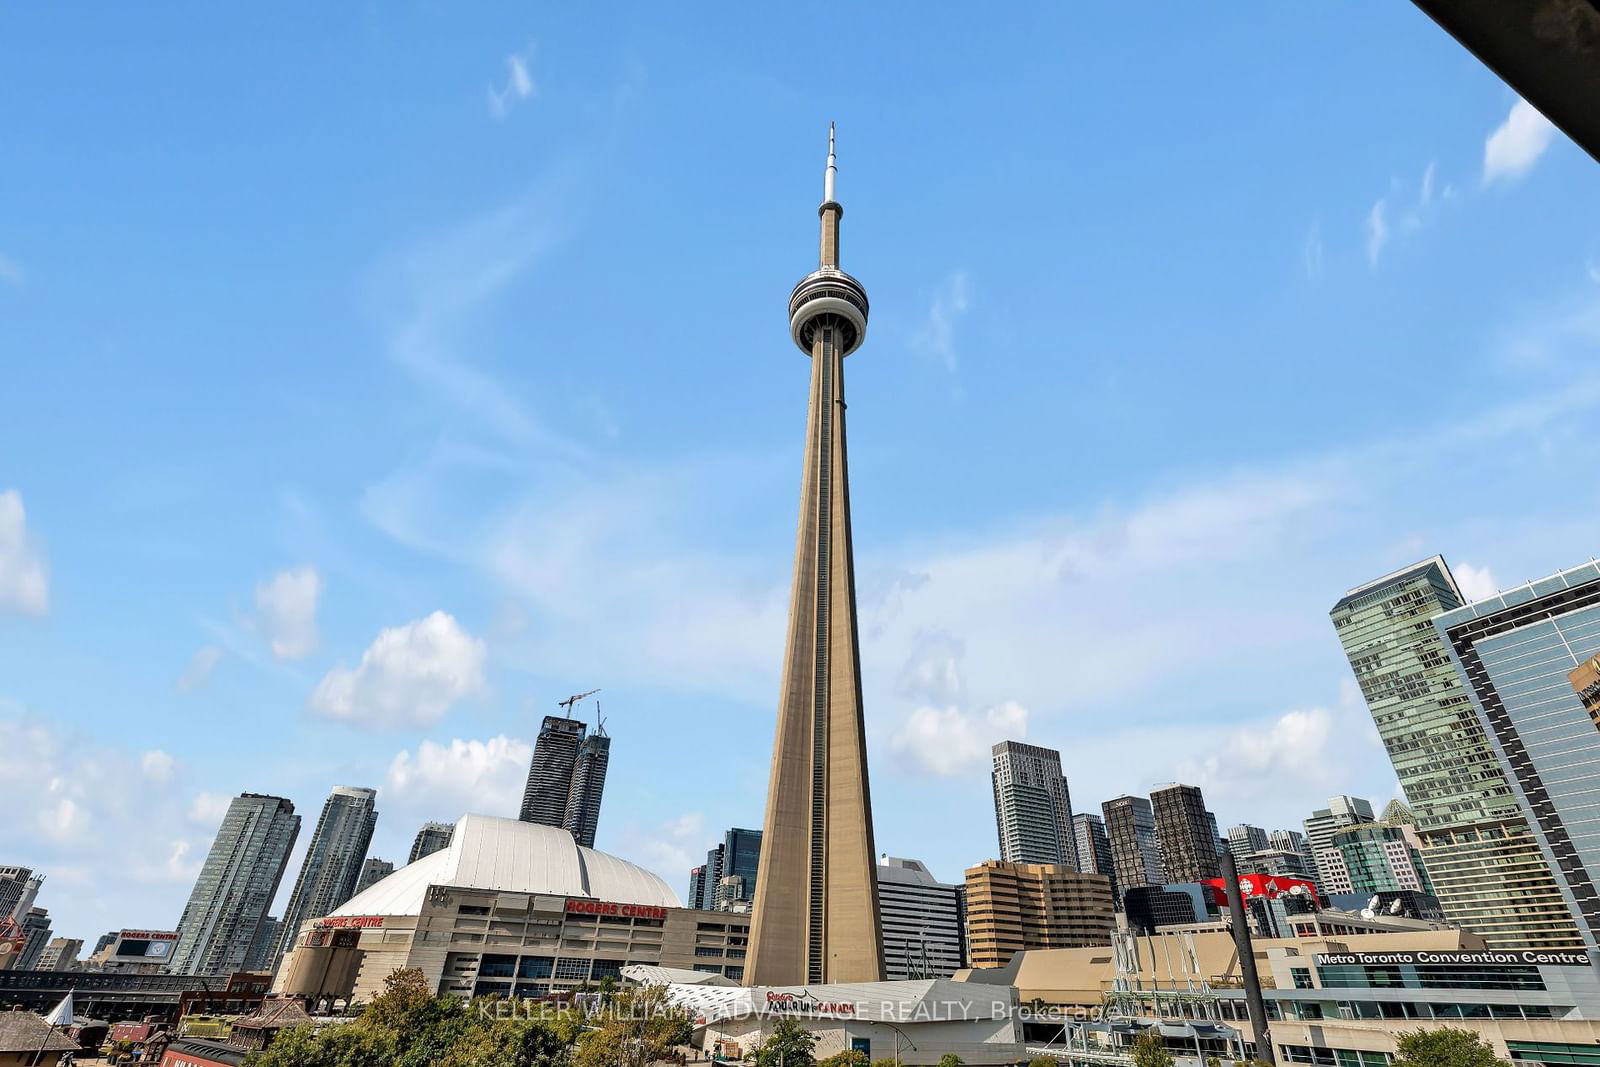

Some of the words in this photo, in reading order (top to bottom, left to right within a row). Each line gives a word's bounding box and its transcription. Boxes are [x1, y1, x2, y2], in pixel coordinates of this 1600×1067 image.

[567, 900, 618, 914] ROGERS
[621, 905, 668, 919] CENTRE
[350, 916, 384, 927] CENTRE
[1317, 953, 1355, 965] Metro
[1356, 952, 1413, 964] Toronto
[1416, 951, 1519, 963] Convention
[1522, 951, 1589, 964] Centre
[818, 1002, 855, 1014] CANADA
